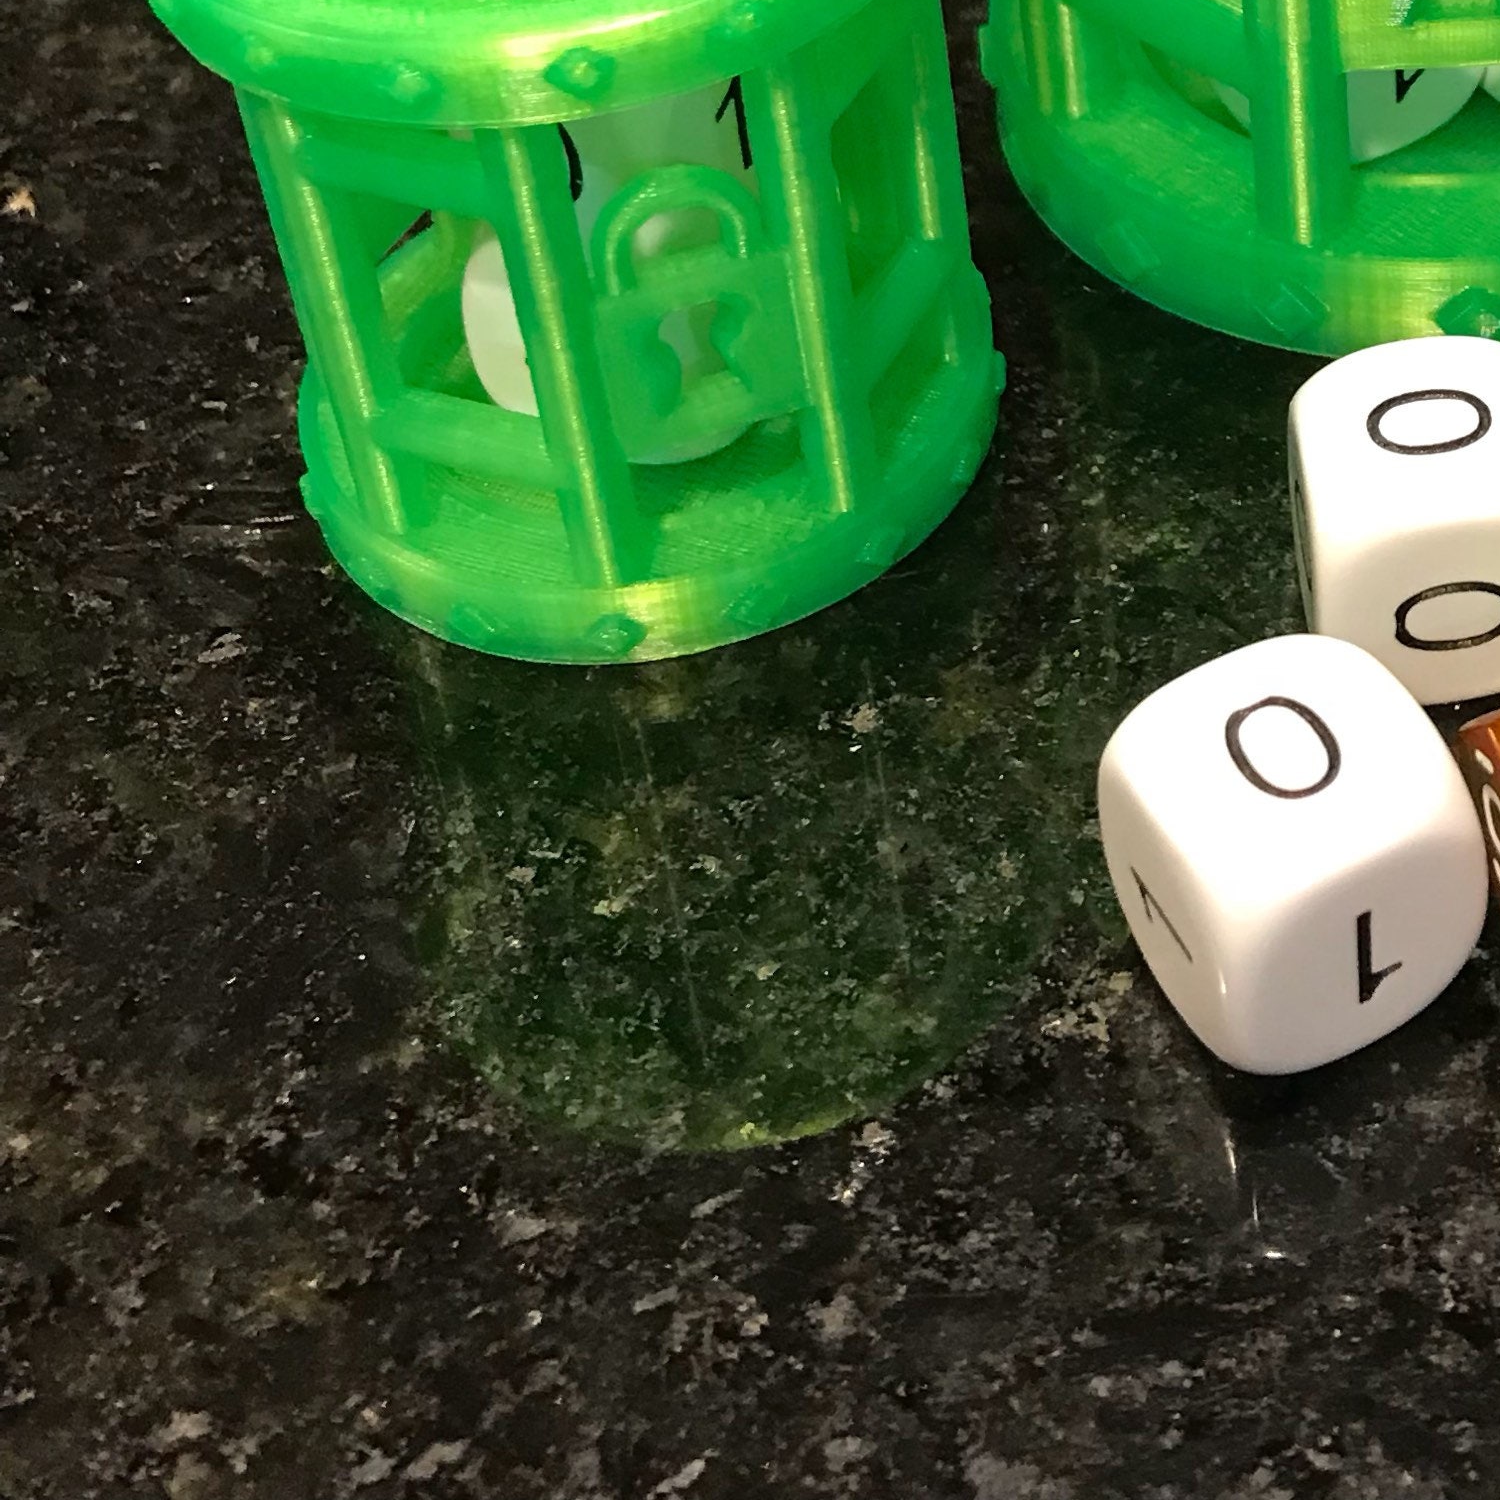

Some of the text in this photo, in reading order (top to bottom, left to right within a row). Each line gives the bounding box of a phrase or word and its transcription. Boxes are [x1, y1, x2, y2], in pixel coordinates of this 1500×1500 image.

[715, 74, 753, 170] 1
[1366, 389, 1492, 455] 0
[1225, 696, 1341, 799] 0
[1355, 909, 1403, 1004] 1
